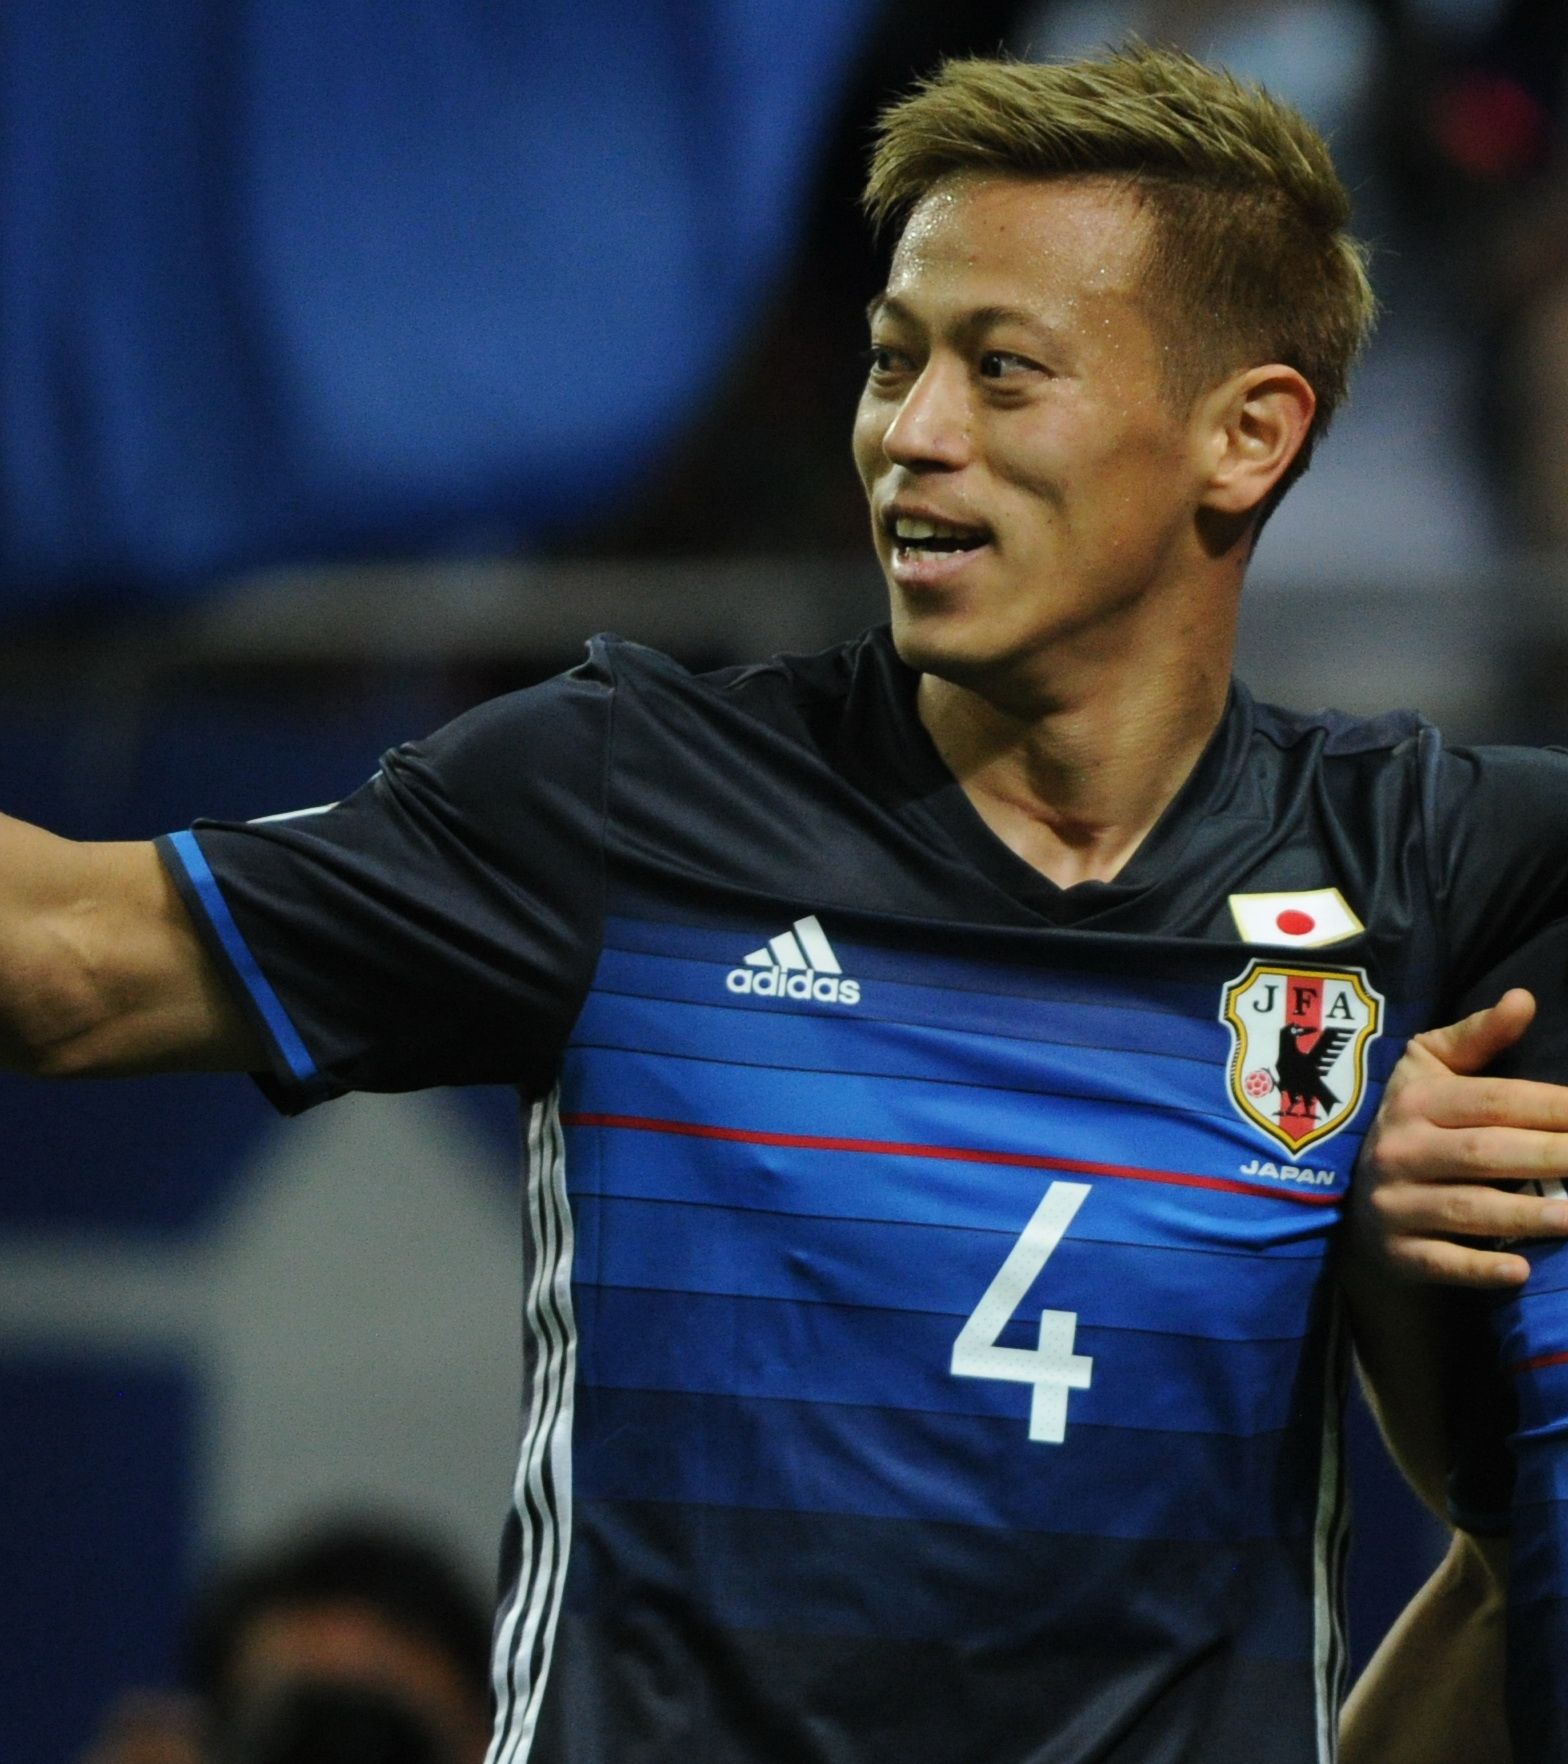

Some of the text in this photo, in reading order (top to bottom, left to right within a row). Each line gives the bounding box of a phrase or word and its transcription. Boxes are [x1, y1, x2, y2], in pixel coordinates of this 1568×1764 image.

[726, 964, 861, 1006] adidas
[1253, 984, 1355, 1021] JFA
[1240, 1159, 1335, 1185] JAPAN
[950, 1181, 1093, 1443] 4
